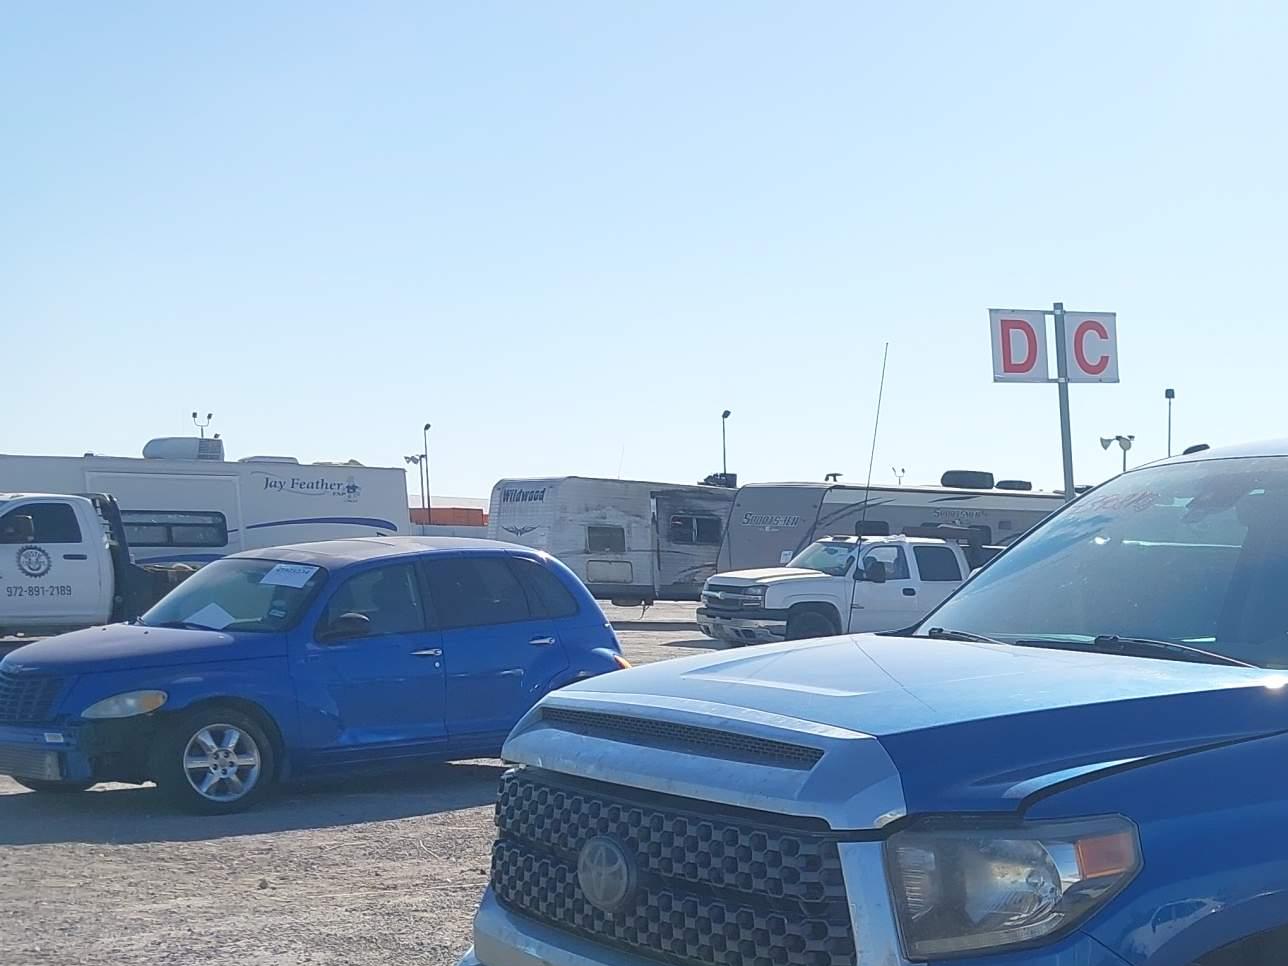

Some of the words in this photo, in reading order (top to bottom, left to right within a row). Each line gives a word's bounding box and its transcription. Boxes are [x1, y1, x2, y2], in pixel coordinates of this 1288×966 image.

[1000, 319, 1038, 374] D
[1073, 320, 1110, 376] C
[263, 477, 287, 492] Jay
[290, 478, 344, 491] Feather
[502, 487, 546, 503] Wildwood
[6, 585, 72, 597] 972-891-2189
